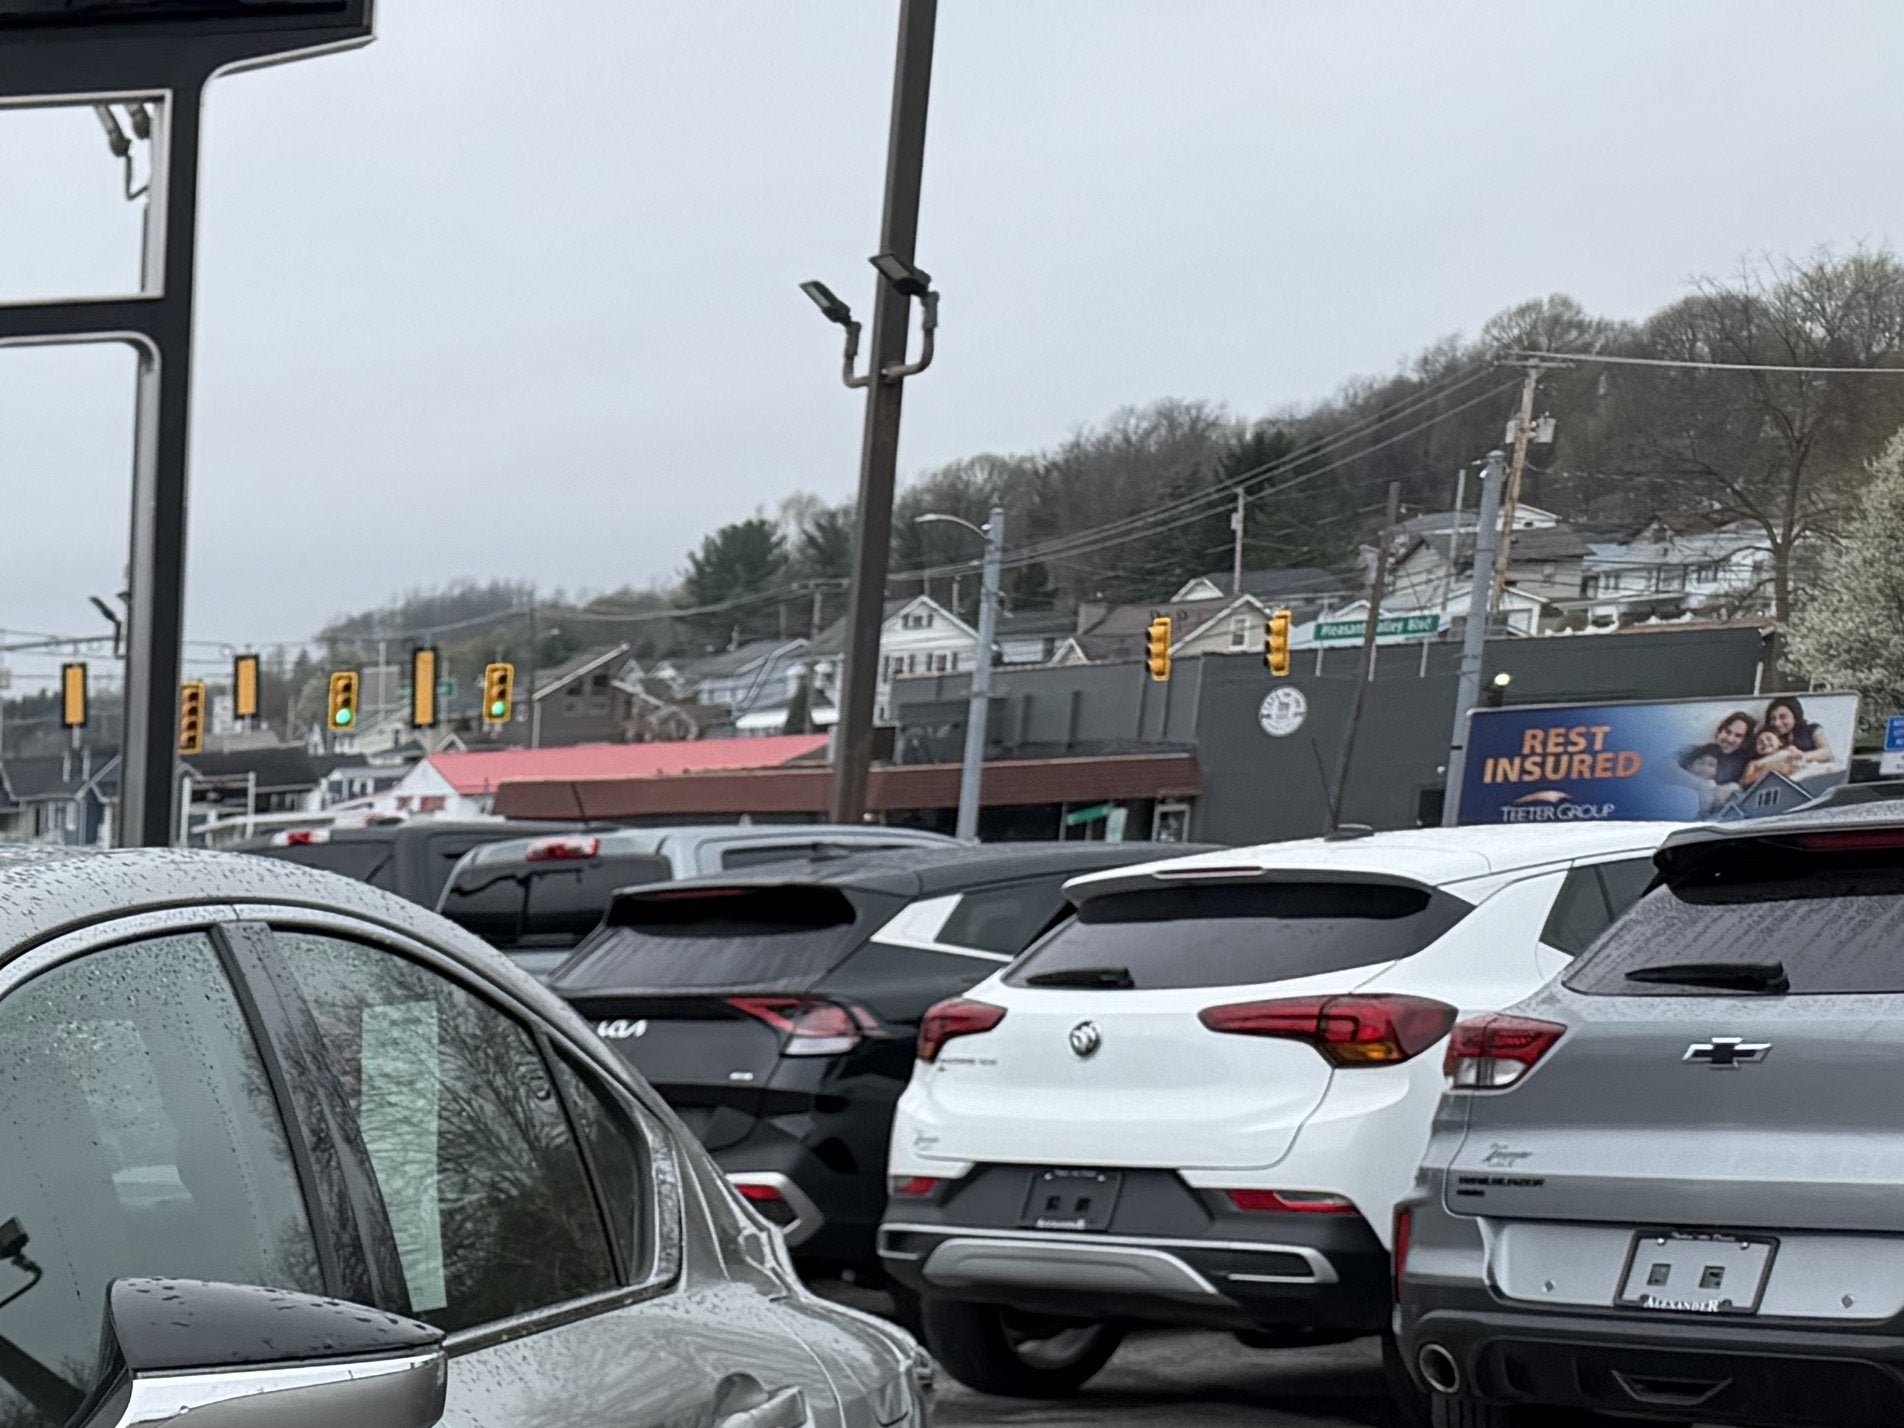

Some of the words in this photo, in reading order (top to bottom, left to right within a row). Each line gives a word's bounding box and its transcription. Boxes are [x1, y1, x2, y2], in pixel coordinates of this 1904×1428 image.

[1407, 617, 1433, 631] Blvd
[1522, 725, 1611, 754] REST
[1483, 751, 1642, 784] INSURED
[1501, 805, 1555, 822] TEETER
[1556, 803, 1615, 819] GROUP
[1643, 1296, 1719, 1312] ALEXANDER
